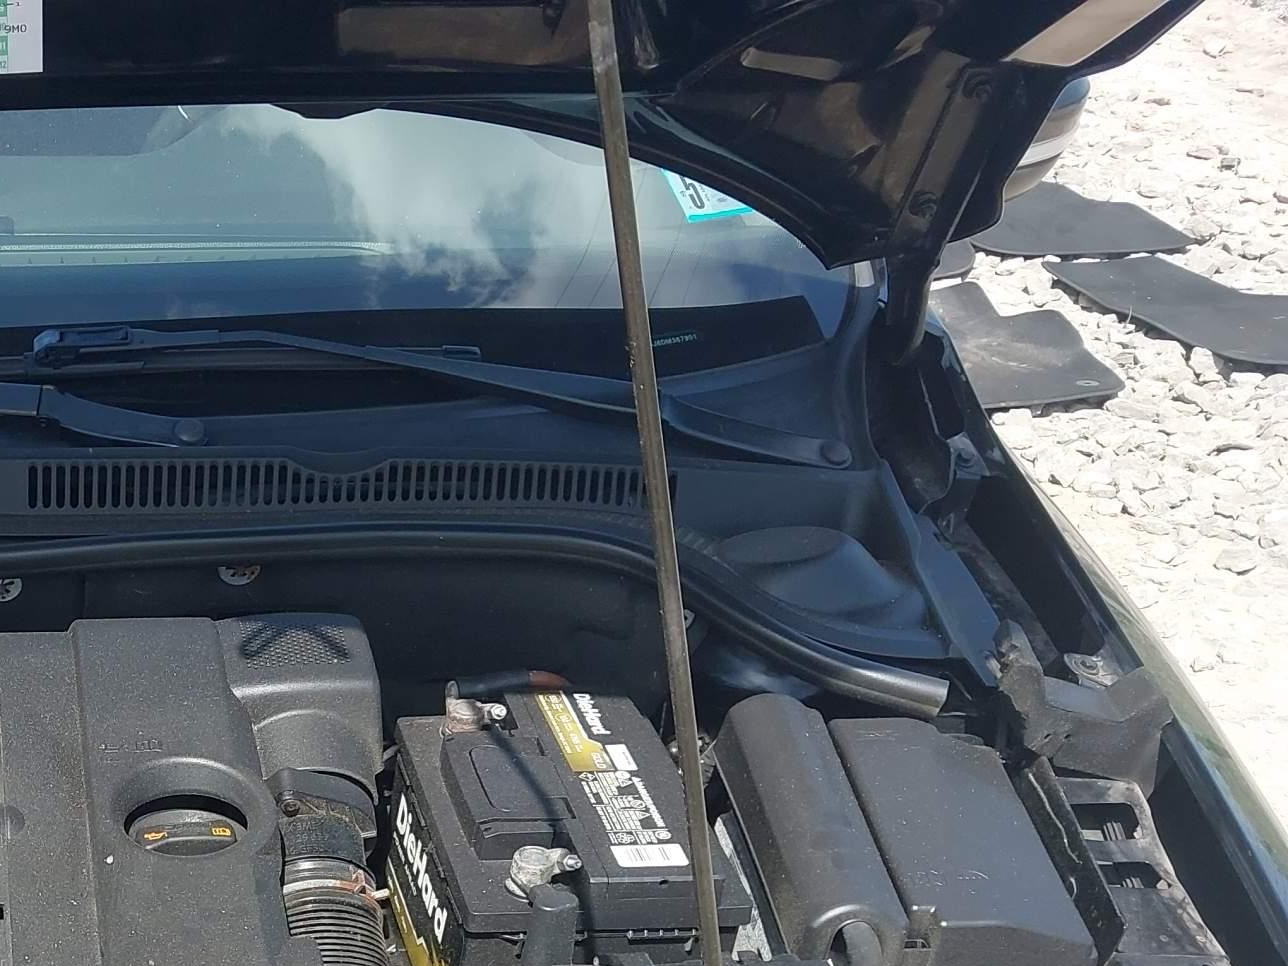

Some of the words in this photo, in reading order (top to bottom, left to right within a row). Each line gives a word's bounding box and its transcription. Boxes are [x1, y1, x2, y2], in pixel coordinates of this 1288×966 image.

[4, 24, 26, 34] 9M0
[0, 42, 6, 50] 11
[0, 61, 6, 69] 12
[572, 692, 612, 737] DieHard
[395, 793, 448, 943] DieHard
